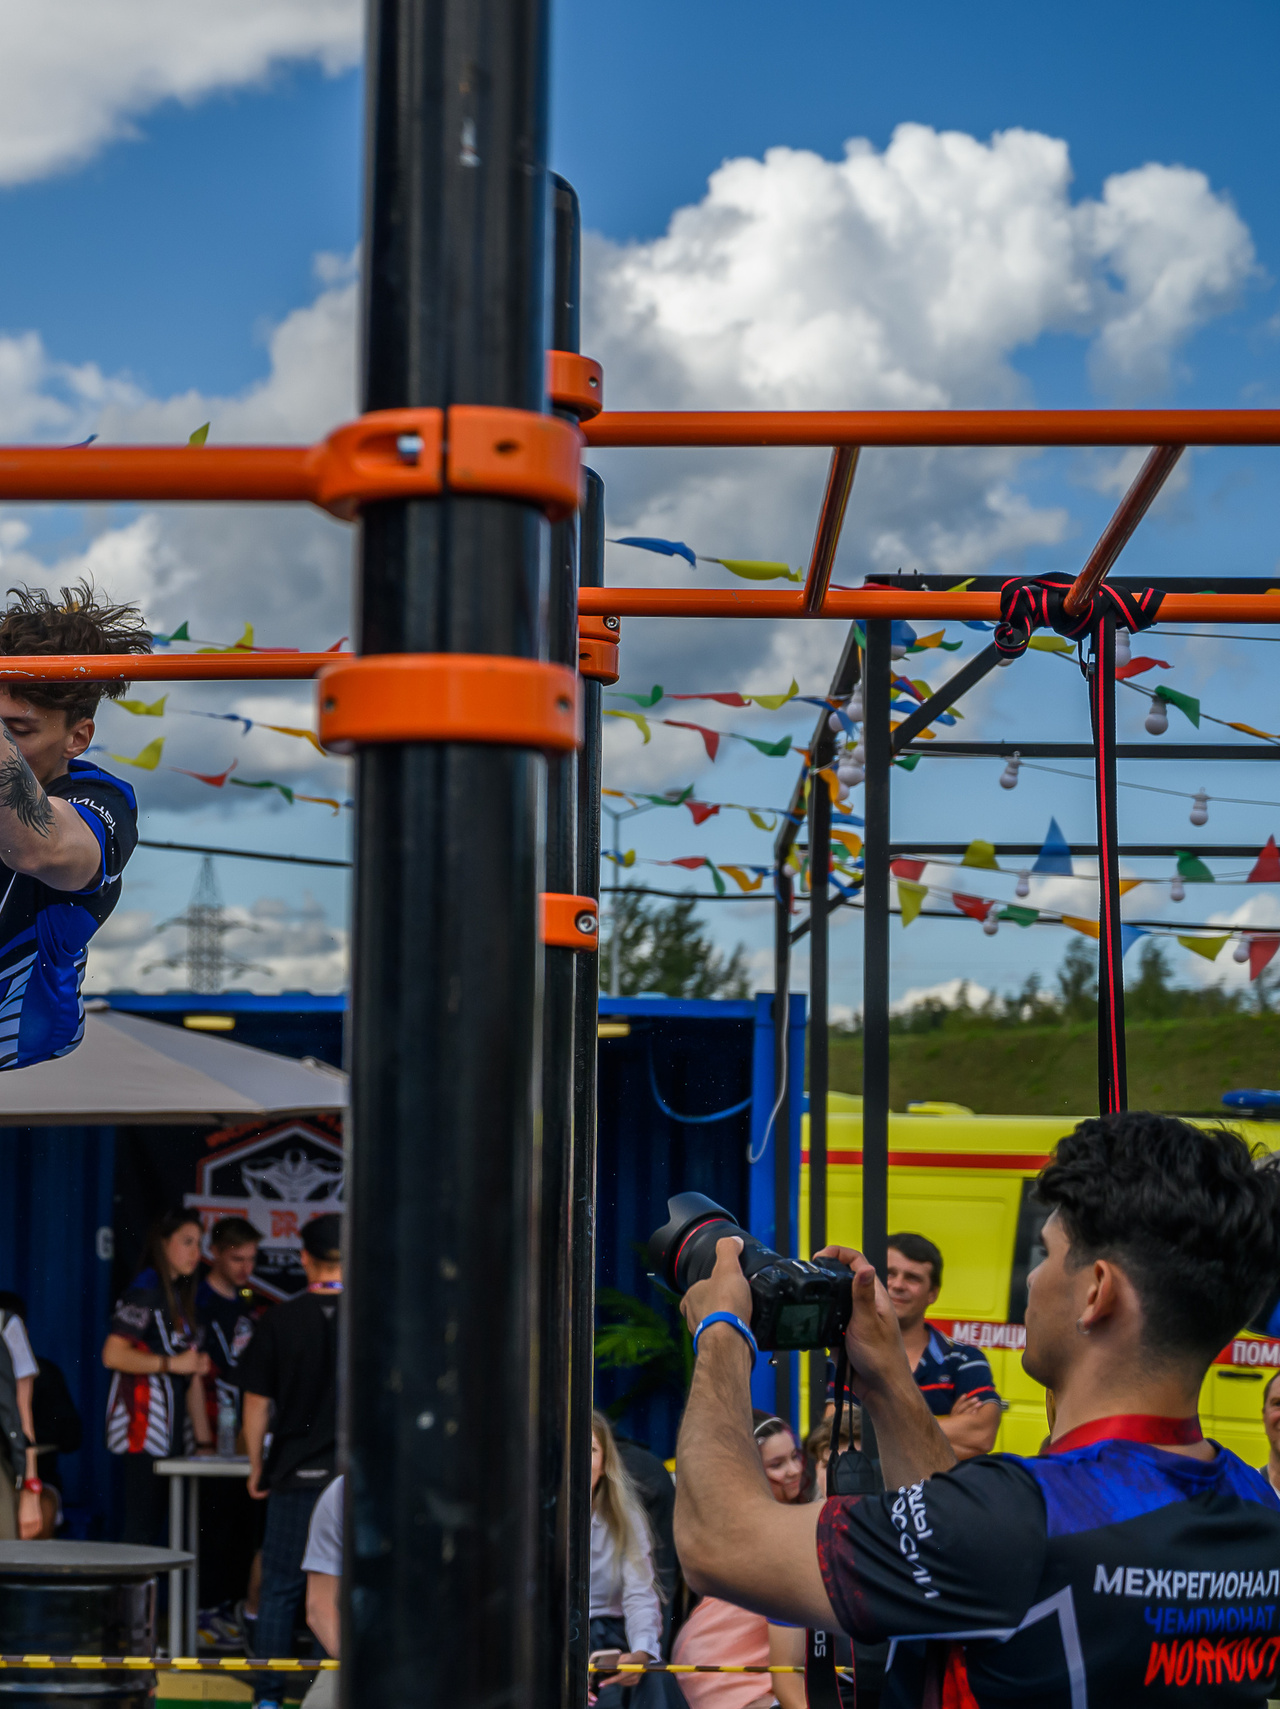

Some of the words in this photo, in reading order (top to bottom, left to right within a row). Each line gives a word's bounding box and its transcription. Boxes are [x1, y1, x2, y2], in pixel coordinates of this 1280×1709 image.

[952, 1321, 1027, 1350] МЕДИЦИ
[1233, 1340, 1280, 1366] ПОМ
[1093, 1563, 1280, 1600] МЕЖРЕГИОНАЛ
[1144, 1604, 1276, 1635] ЧЕМПИОНАТ
[814, 1630, 826, 1657] OS
